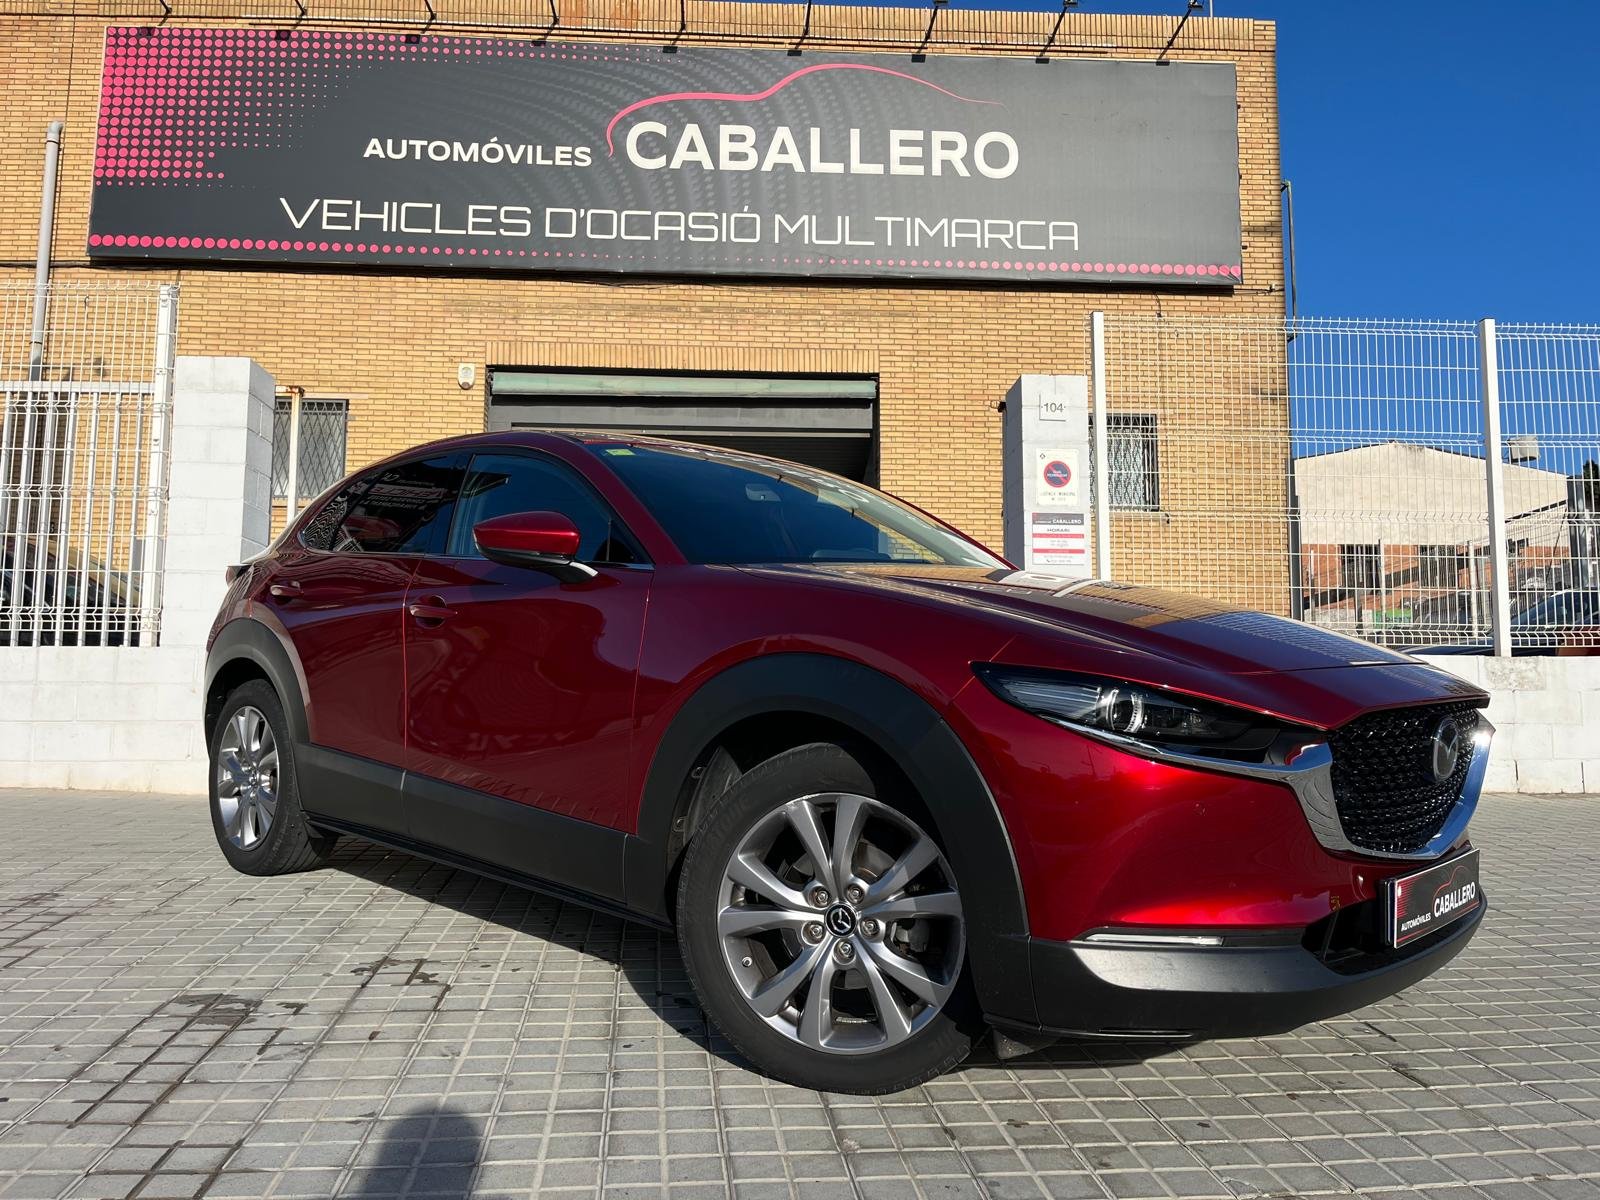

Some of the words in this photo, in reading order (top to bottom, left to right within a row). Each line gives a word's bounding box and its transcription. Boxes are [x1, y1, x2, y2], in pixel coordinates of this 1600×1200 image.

[363, 136, 592, 167] AUTOMÓVILES
[625, 120, 1019, 179] CABALLERO
[279, 197, 532, 237] VEHICLES
[544, 205, 761, 243] D'OCASIÓ
[774, 213, 1079, 250] MULTIMARCA
[1043, 402, 1065, 413] 104
[1401, 912, 1431, 932] AUTOMÓVILES
[1434, 881, 1476, 917] CABALLERO
